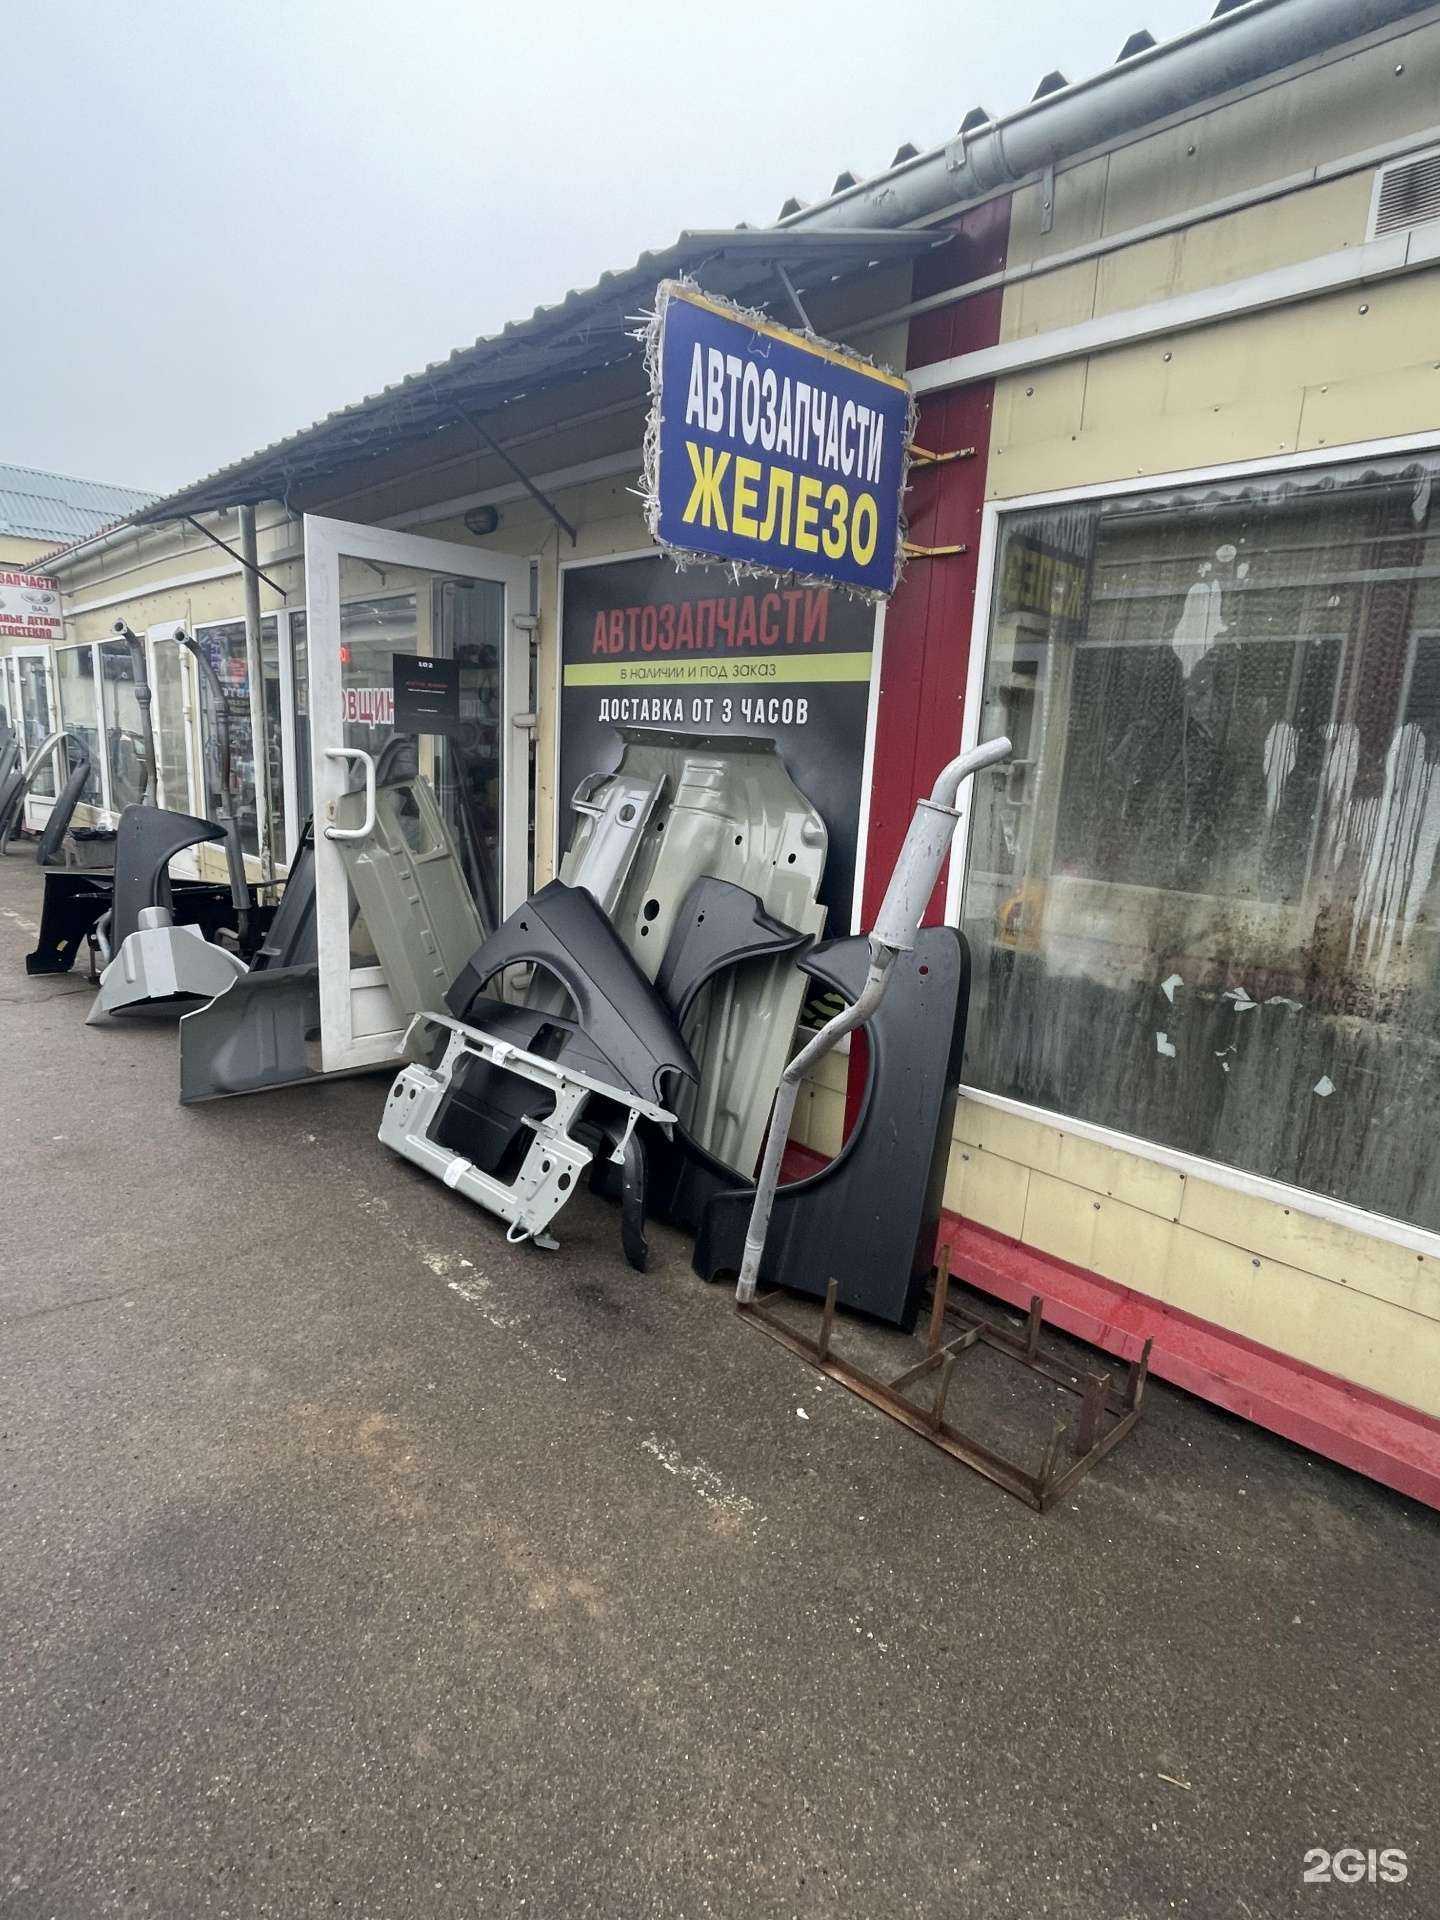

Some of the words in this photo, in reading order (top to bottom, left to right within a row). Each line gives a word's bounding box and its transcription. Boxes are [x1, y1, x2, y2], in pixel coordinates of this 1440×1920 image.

[685, 342, 885, 484] АВТОЗАПЧАСТИ
[682, 440, 878, 566] ЖЕЛЕЗО
[592, 589, 830, 654] АВТОЗАПЧАСТИ
[631, 667, 685, 680] наличии
[700, 665, 728, 679] под
[733, 663, 776, 677] заказ
[598, 698, 684, 722] ДОСТАВКА
[692, 698, 714, 722] ОТ
[722, 698, 733, 723] 3
[741, 698, 809, 724] ЧАСОВ
